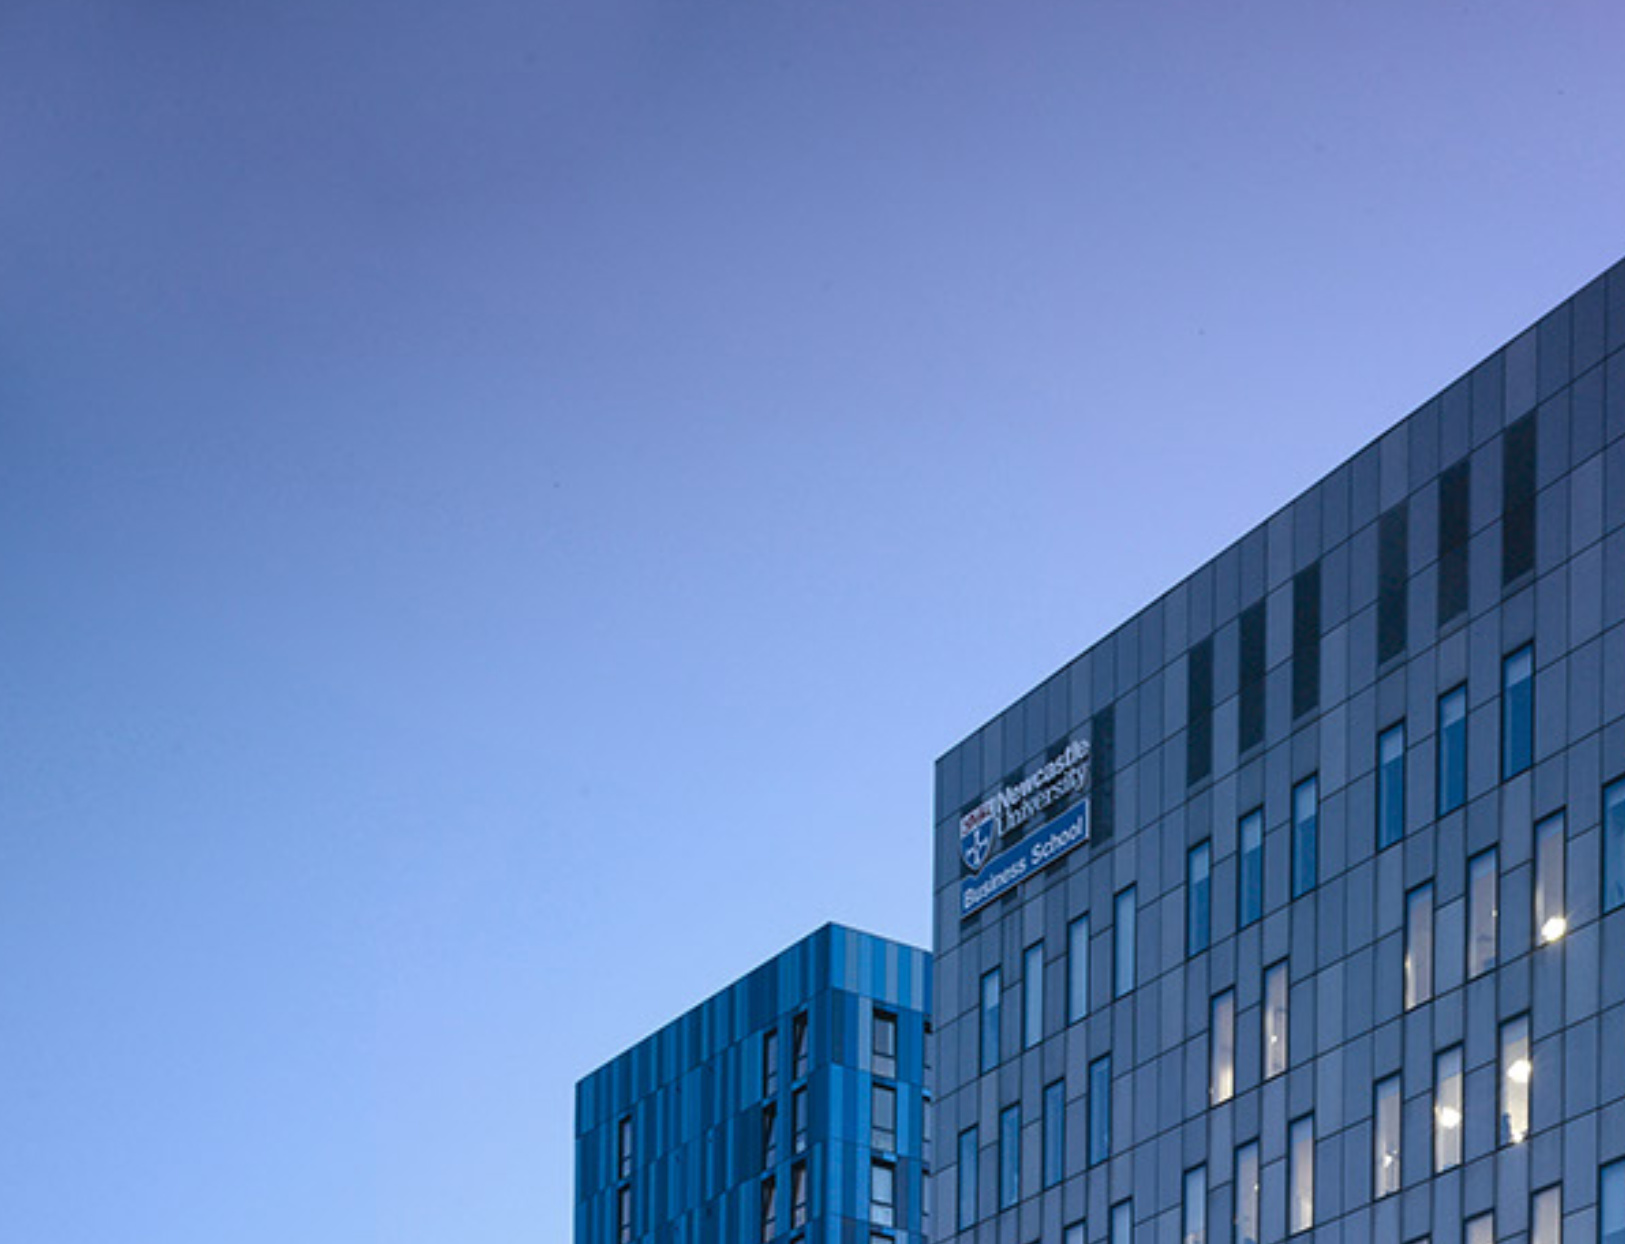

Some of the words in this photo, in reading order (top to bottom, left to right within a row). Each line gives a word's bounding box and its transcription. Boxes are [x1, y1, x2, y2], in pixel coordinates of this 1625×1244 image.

[997, 740, 1091, 810] Newcastle
[965, 858, 1027, 908] Business
[1030, 815, 1084, 865] School
